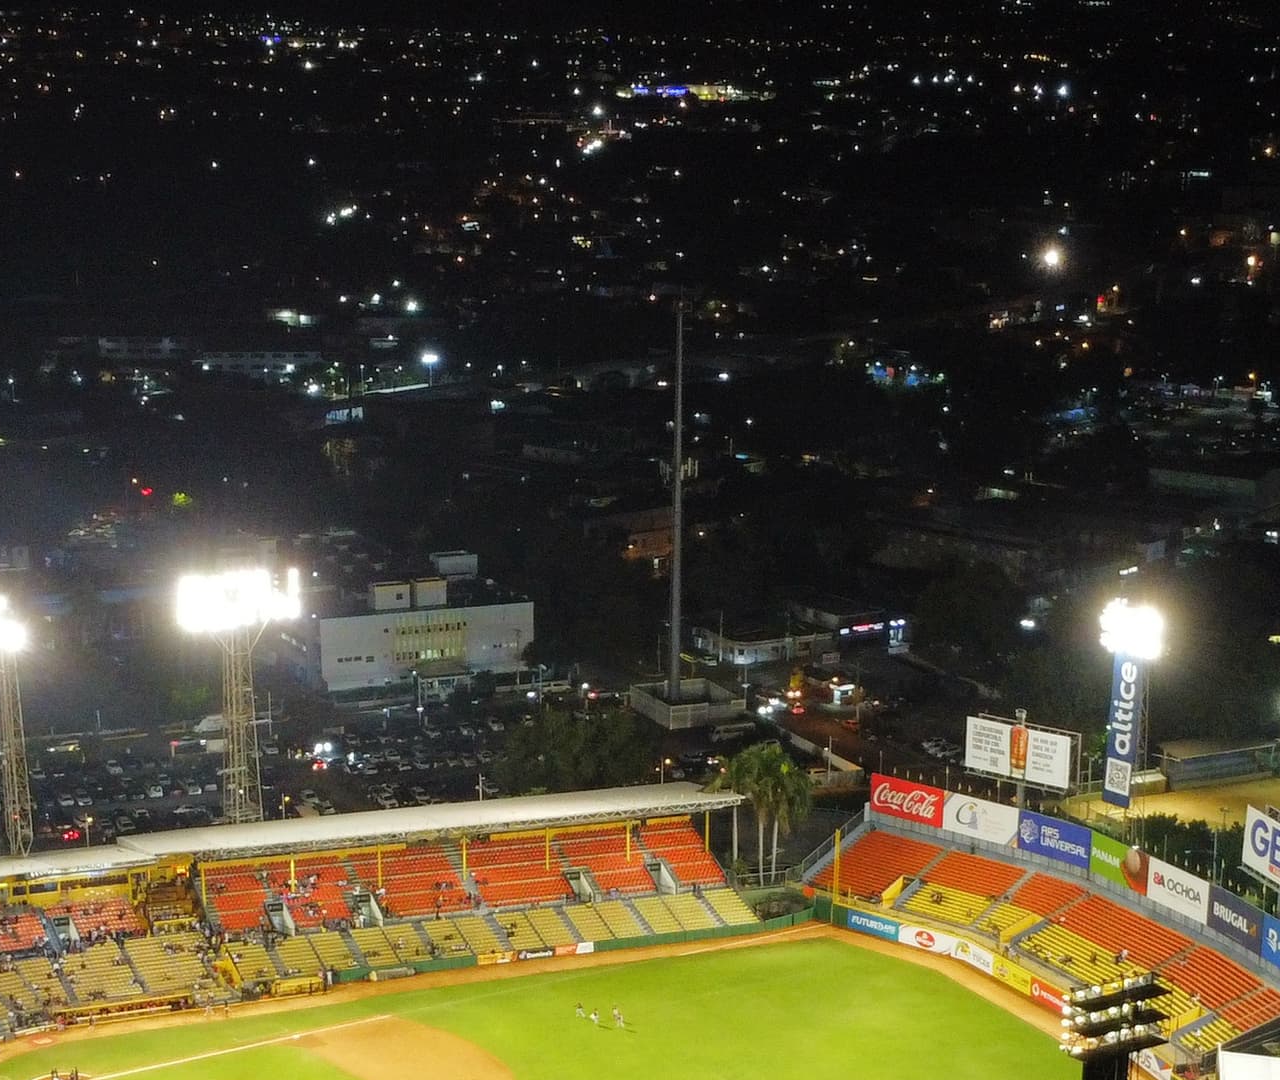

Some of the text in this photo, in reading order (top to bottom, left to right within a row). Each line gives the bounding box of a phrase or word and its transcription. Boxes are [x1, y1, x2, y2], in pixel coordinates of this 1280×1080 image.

[1112, 661, 1137, 755] altice
[1040, 835, 1089, 859] UNIVERSAL
[1166, 878, 1202, 905] OCHOA
[1213, 901, 1249, 934] BRUGAL
